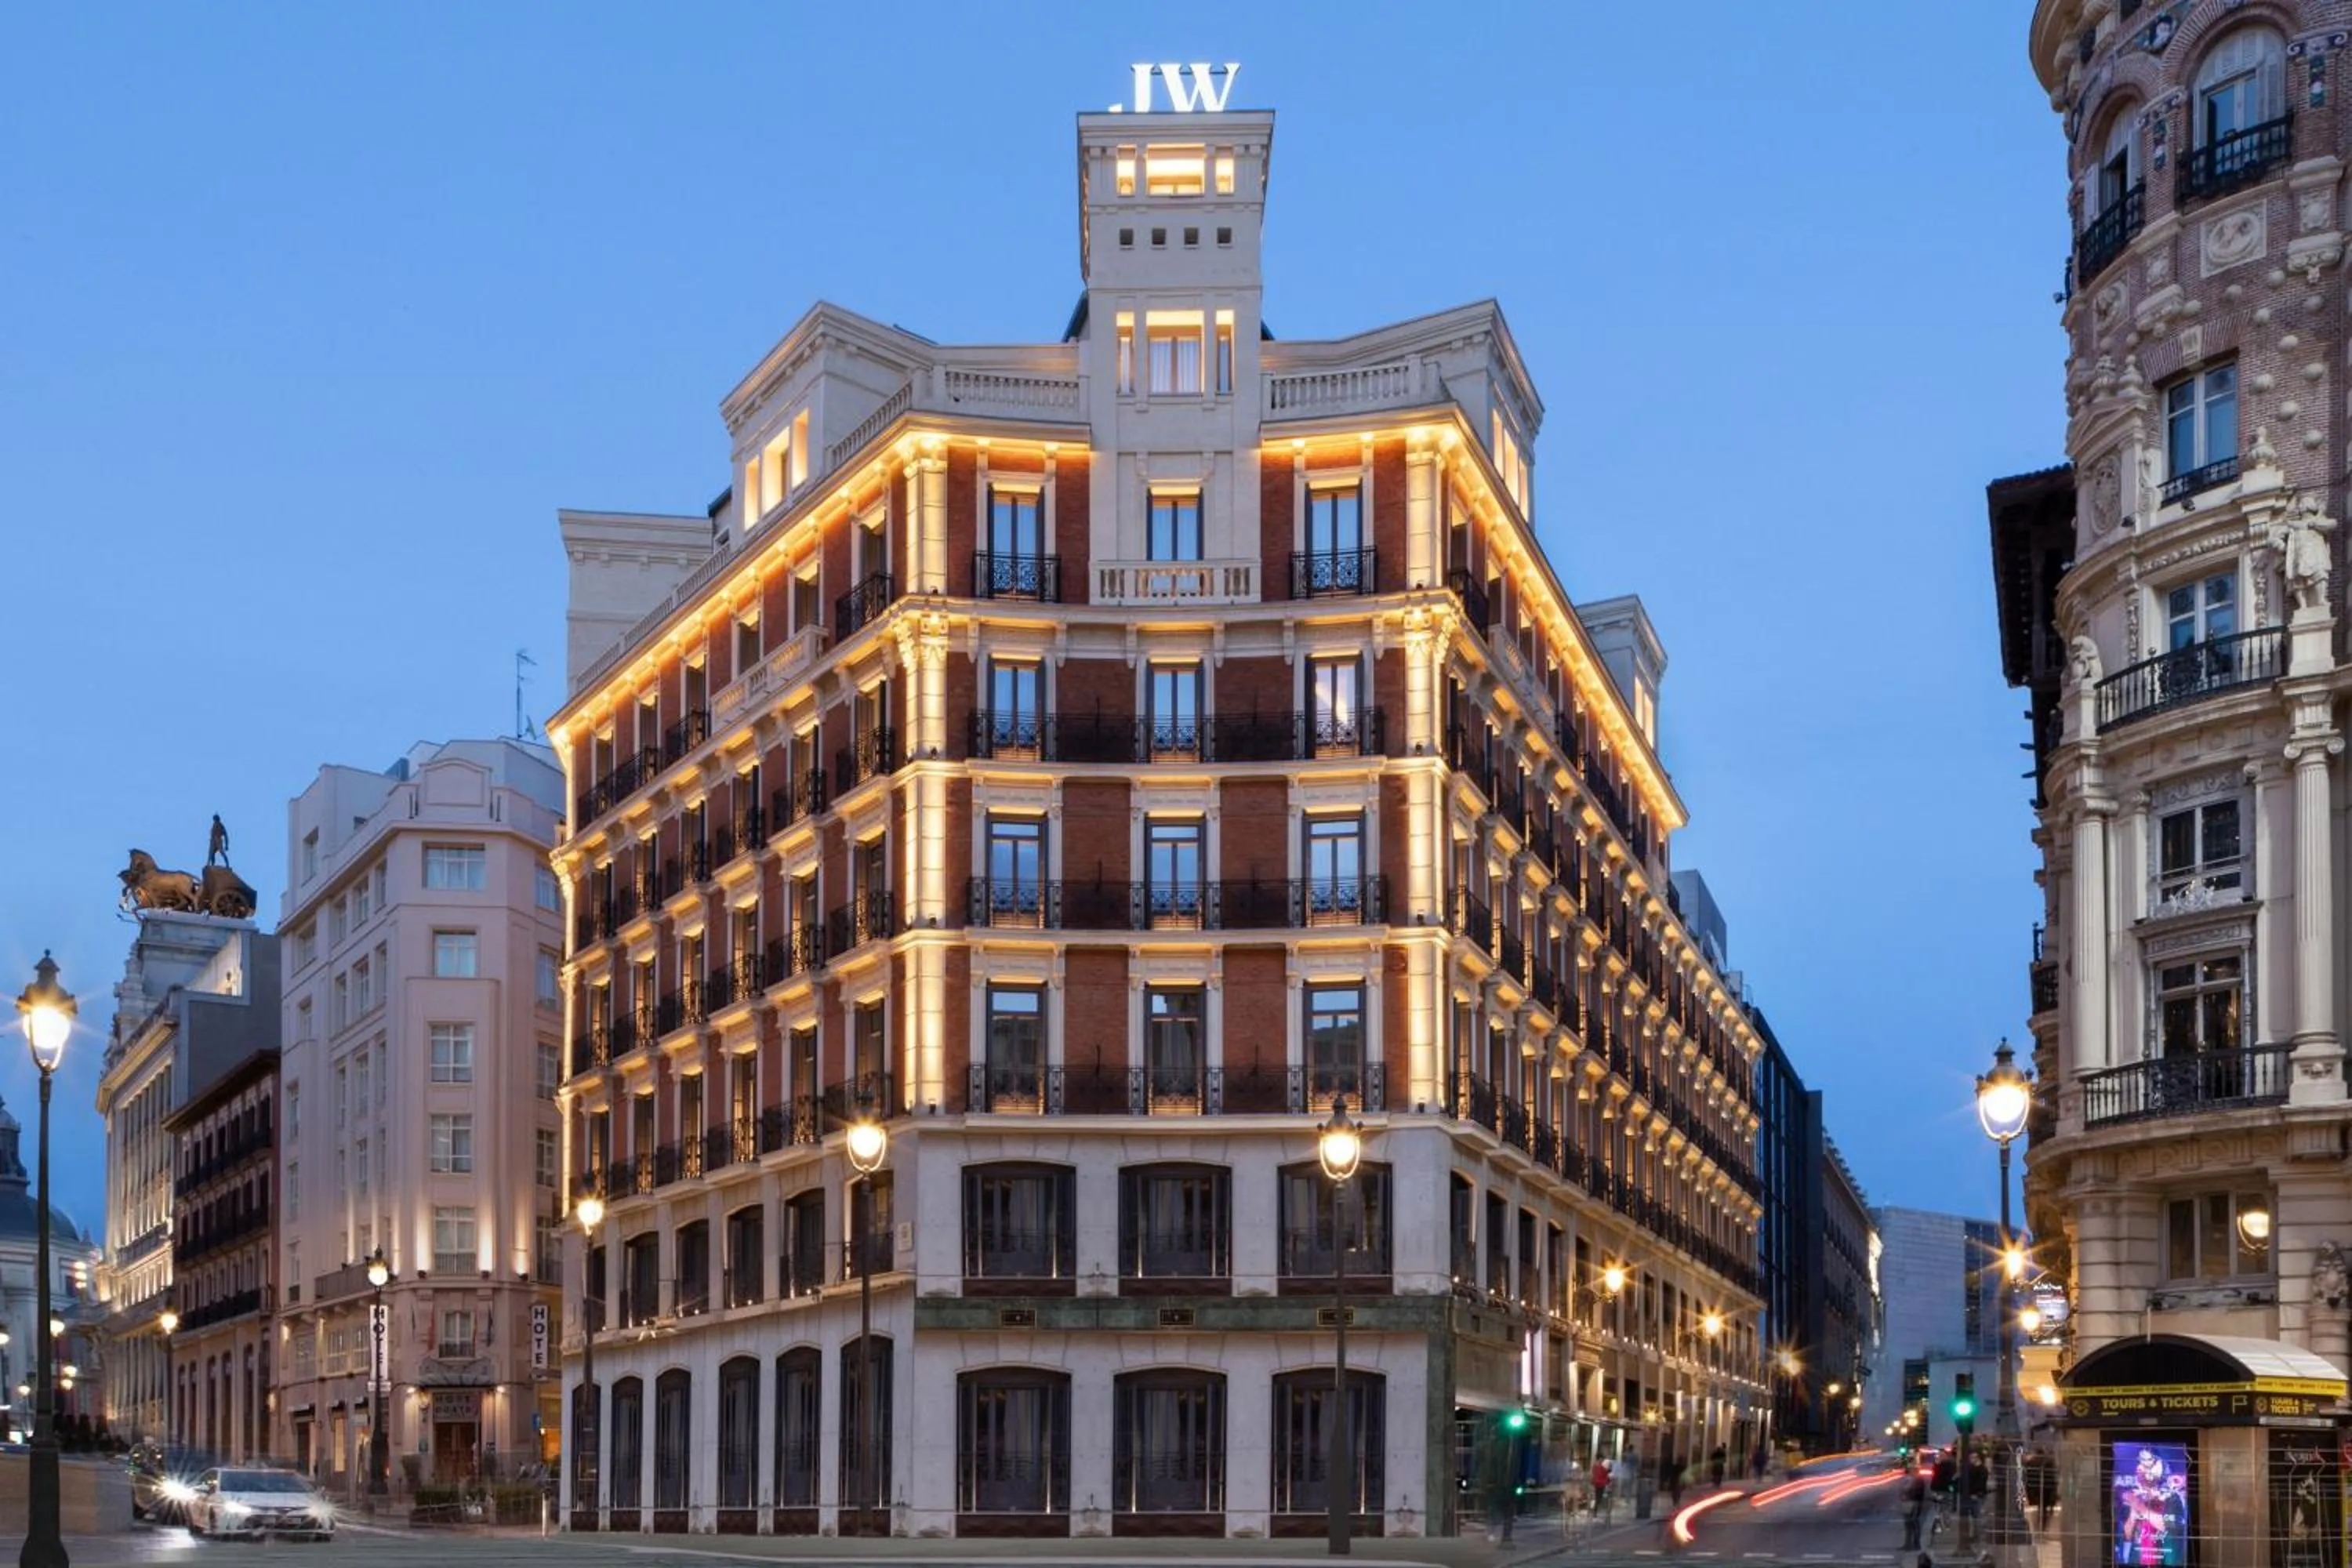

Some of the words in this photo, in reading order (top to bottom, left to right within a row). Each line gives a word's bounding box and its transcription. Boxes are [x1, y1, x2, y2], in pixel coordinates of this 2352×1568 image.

[1108, 63, 1240, 112] JW
[2101, 1397, 2145, 1410] TOURS
[2160, 1396, 2219, 1408] TICKETS
